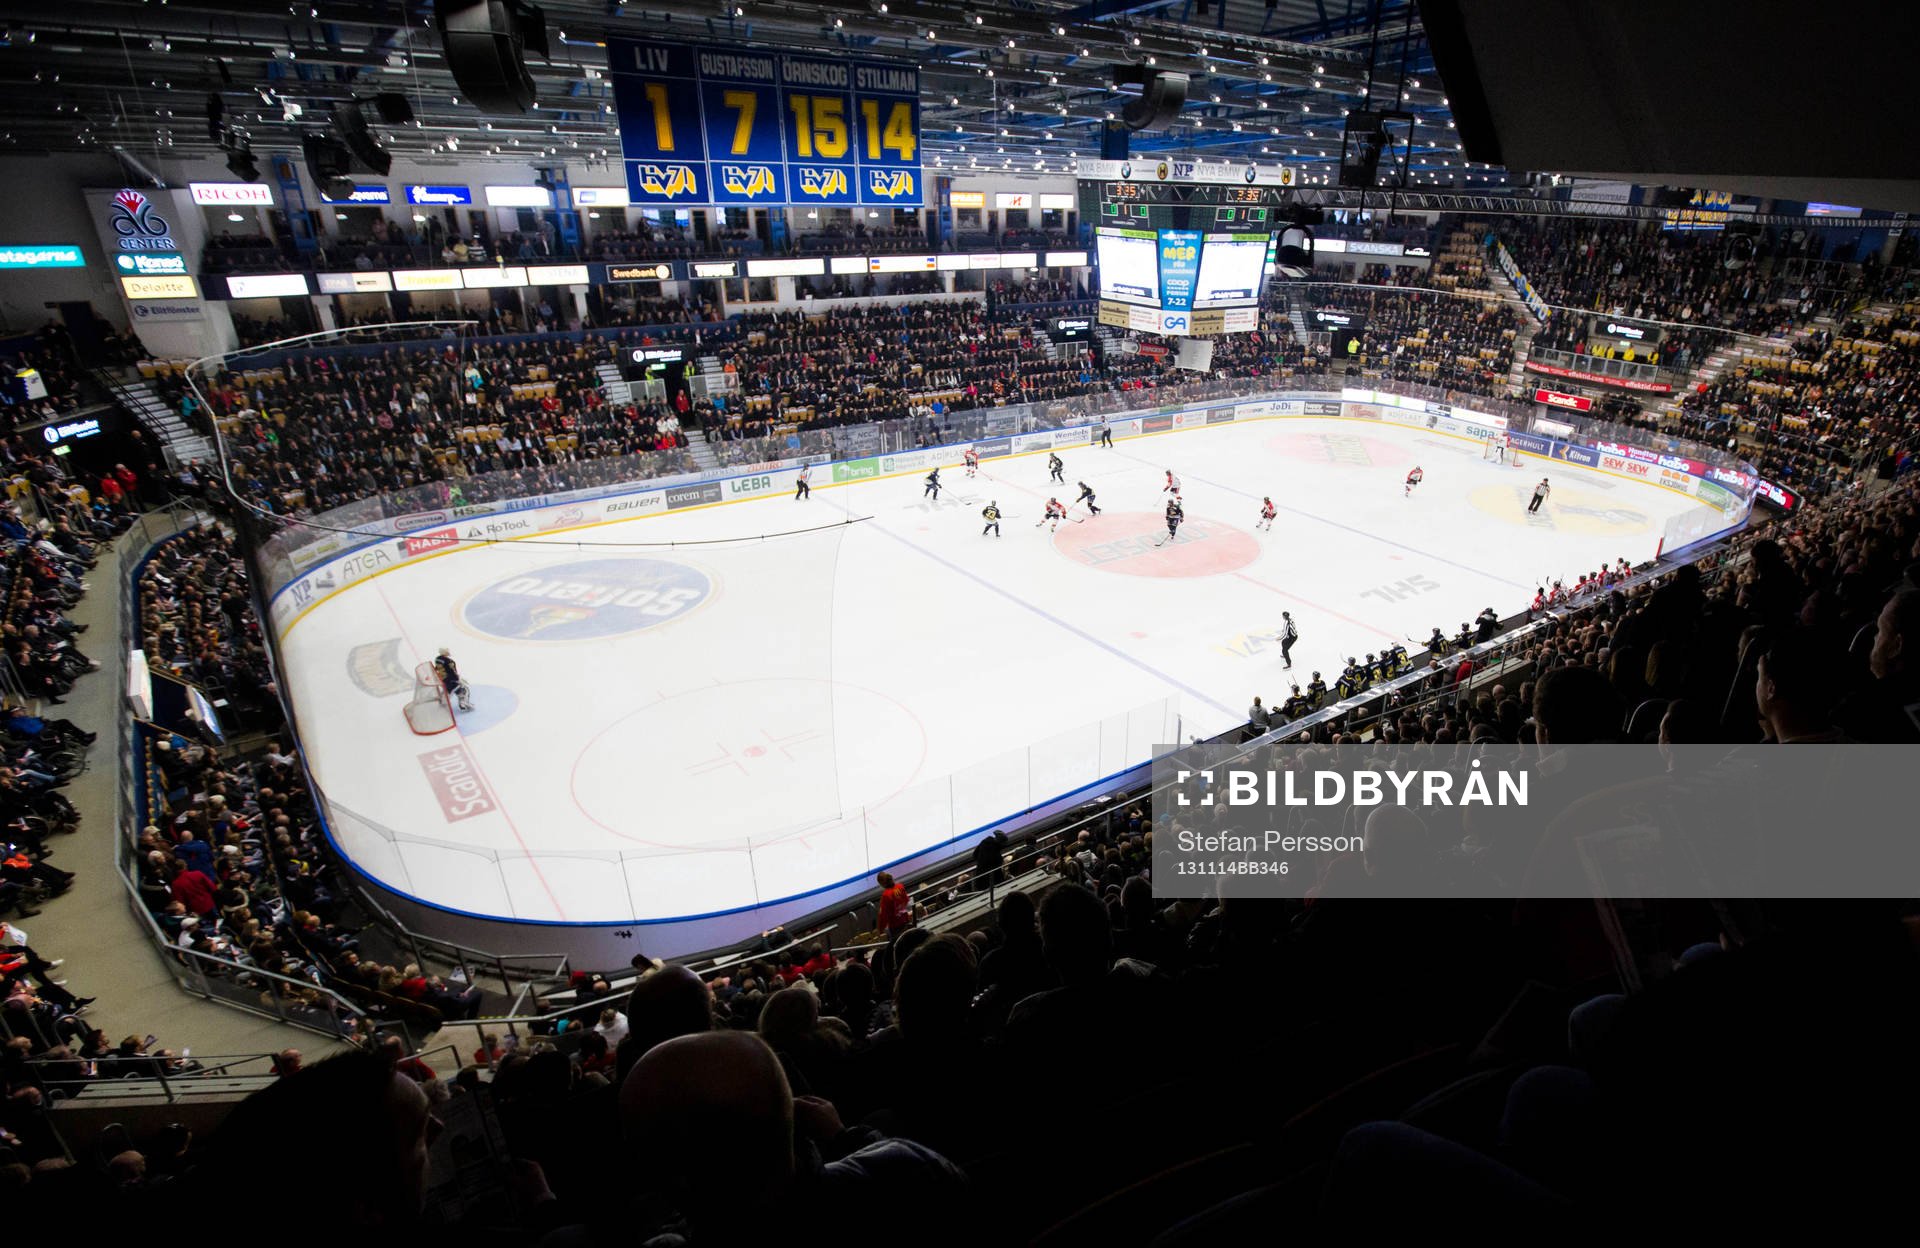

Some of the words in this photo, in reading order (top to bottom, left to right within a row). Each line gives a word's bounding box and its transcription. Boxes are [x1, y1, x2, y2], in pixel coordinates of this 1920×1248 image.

[635, 46, 669, 72] LIV
[701, 55, 774, 80] GUSTAFSSON
[782, 56, 848, 86] ÖRNSKOG
[857, 70, 916, 92] STILLMAN
[645, 82, 674, 151] 1
[723, 90, 757, 155] 7
[790, 94, 848, 158] 15
[861, 100, 916, 160] 14
[197, 188, 267, 200] RICOH
[119, 238, 177, 250] CENTER
[1350, 243, 1399, 255] SKANSKA
[613, 268, 656, 279] Swedbank
[131, 283, 184, 293] Deloitte
[1167, 297, 1187, 306] 7-22
[1547, 393, 1578, 408] Scandic
[1510, 437, 1545, 451] AGERHULT
[1568, 450, 1592, 463] Kitron
[732, 476, 771, 493] LEBA
[668, 490, 700, 503] corem
[428, 748, 489, 816] Scandic
